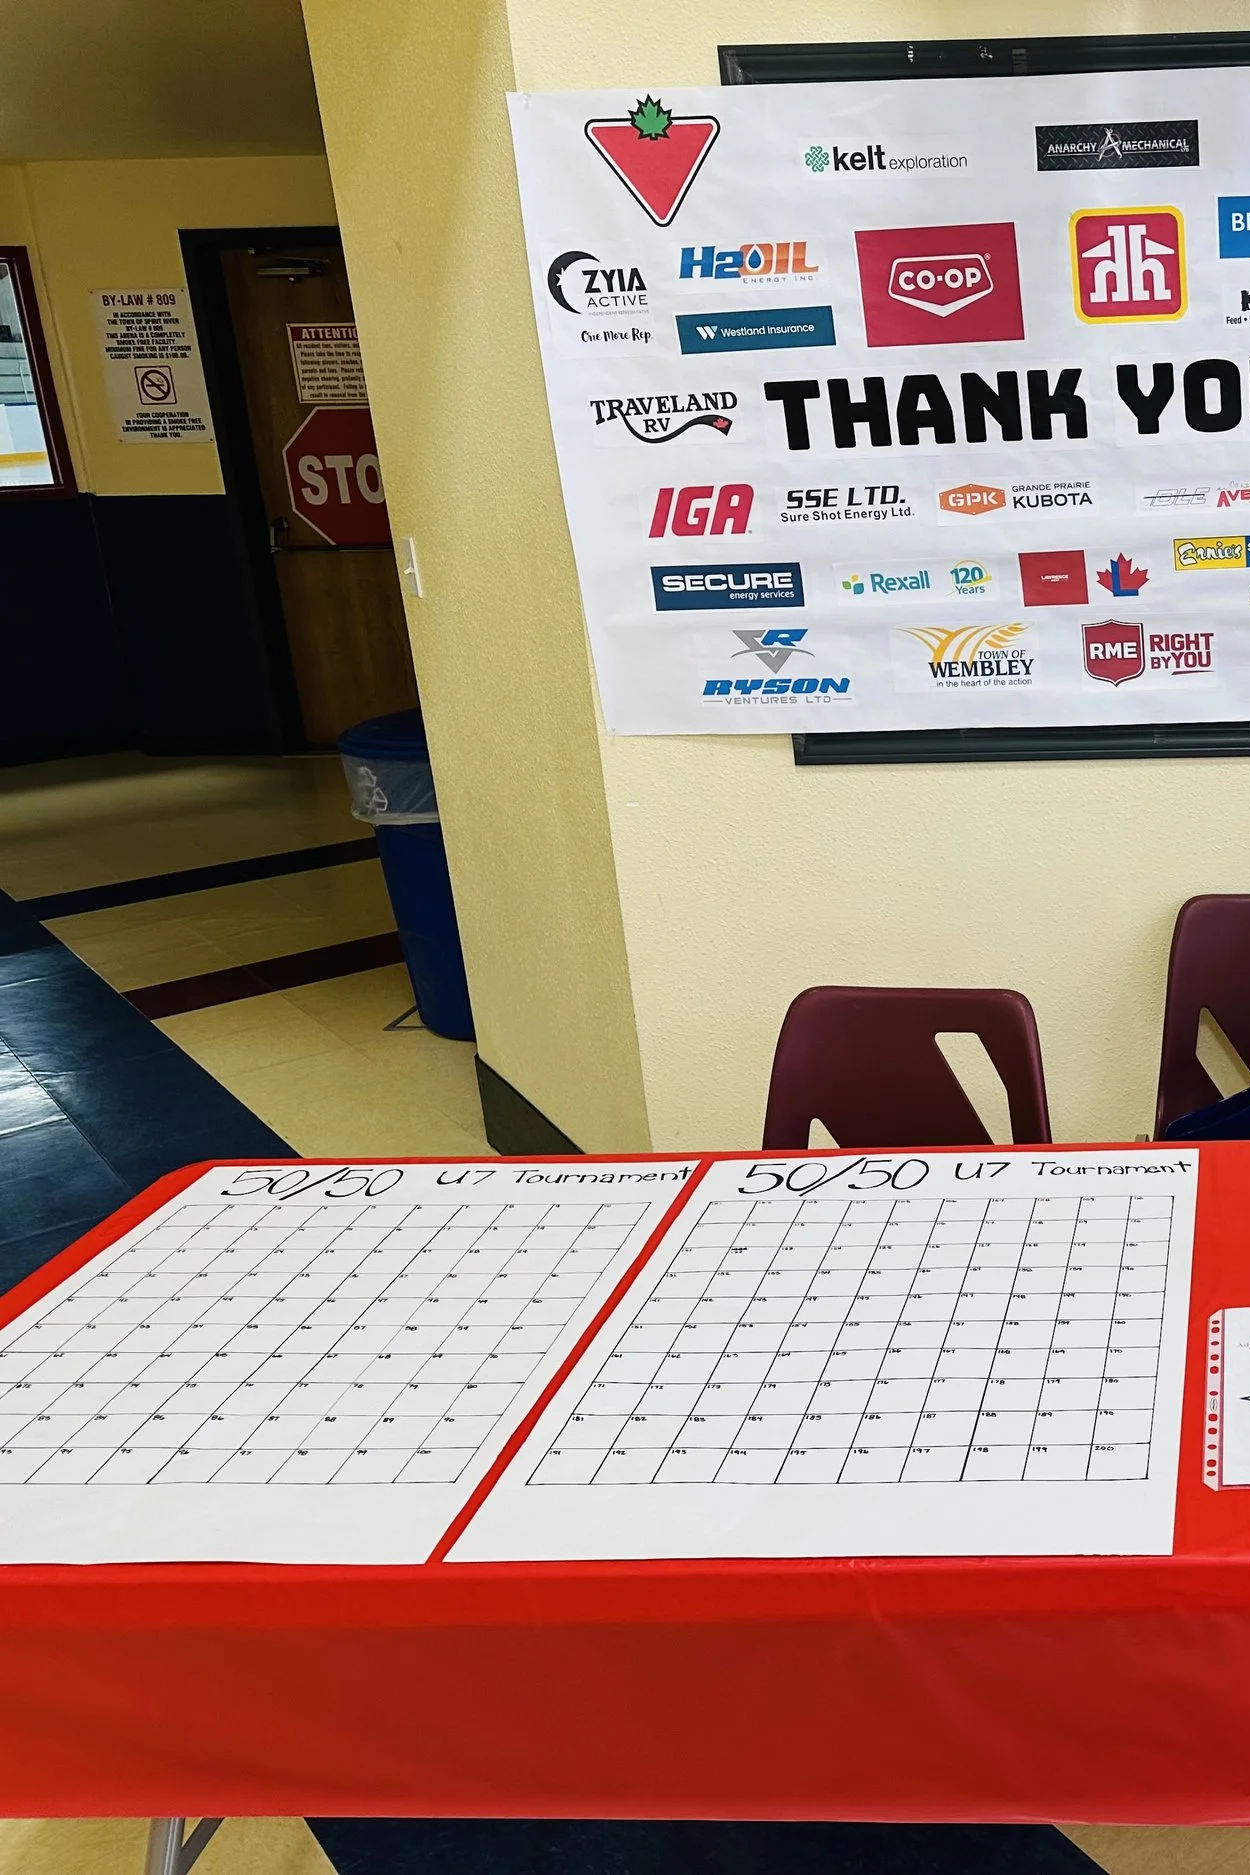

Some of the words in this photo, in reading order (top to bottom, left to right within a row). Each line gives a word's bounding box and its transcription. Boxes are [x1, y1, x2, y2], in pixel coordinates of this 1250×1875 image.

[1047, 140, 1097, 155] ANARCHY
[1121, 138, 1189, 152] MECHANICAL
[833, 145, 886, 173] kelt
[889, 153, 968, 172] exploration
[582, 267, 648, 295] ZYIA
[102, 294, 144, 306] BY-LAW
[147, 294, 153, 305] #
[156, 294, 176, 305] 809
[587, 293, 649, 308] ACTIVE
[1226, 315, 1243, 325] Feed
[302, 328, 358, 340] ATTENTI
[581, 329, 602, 343] One
[603, 328, 631, 343] More
[720, 324, 766, 337] Westland
[768, 323, 815, 335] Insurance
[590, 391, 738, 426] TRAVELAND
[763, 368, 1088, 451] THANK
[644, 418, 671, 433] RV
[298, 453, 386, 506] STO
[1012, 483, 1051, 493] GRANDE
[1054, 481, 1091, 490] PRAIRIE
[786, 487, 839, 509] SSE
[847, 485, 907, 506] LTD.
[948, 491, 999, 506] GPK
[1013, 492, 1093, 509] KUBOTA
[648, 484, 755, 539] IGA
[781, 511, 810, 522] Sure
[813, 509, 842, 520] Shot
[845, 508, 888, 522] Energy
[891, 507, 915, 518] Ltd.
[1176, 541, 1243, 566] Ernie's
[662, 572, 794, 592] SECURE
[871, 570, 930, 594] Rexall
[950, 566, 984, 585] 120
[729, 591, 759, 600] energy
[760, 589, 795, 598] services
[956, 584, 986, 595] Years
[1089, 641, 1139, 660] RME
[1150, 633, 1215, 652] RIGHT
[978, 650, 1009, 660] TOWN
[1011, 650, 1026, 659] OF
[928, 658, 1034, 678] WEMBLEY
[702, 677, 851, 696] RYSON
[961, 679, 981, 687] heart
[1008, 677, 1032, 685] action
[724, 696, 798, 705] VENTURES
[805, 695, 832, 704] LTD
[221, 1166, 404, 1201] 50/50
[436, 1169, 497, 1185] U7
[511, 1166, 693, 1185] Tournament
[738, 1157, 930, 1197] 50/50
[953, 1161, 1012, 1180] U7
[1031, 1160, 1192, 1176] Tournament
